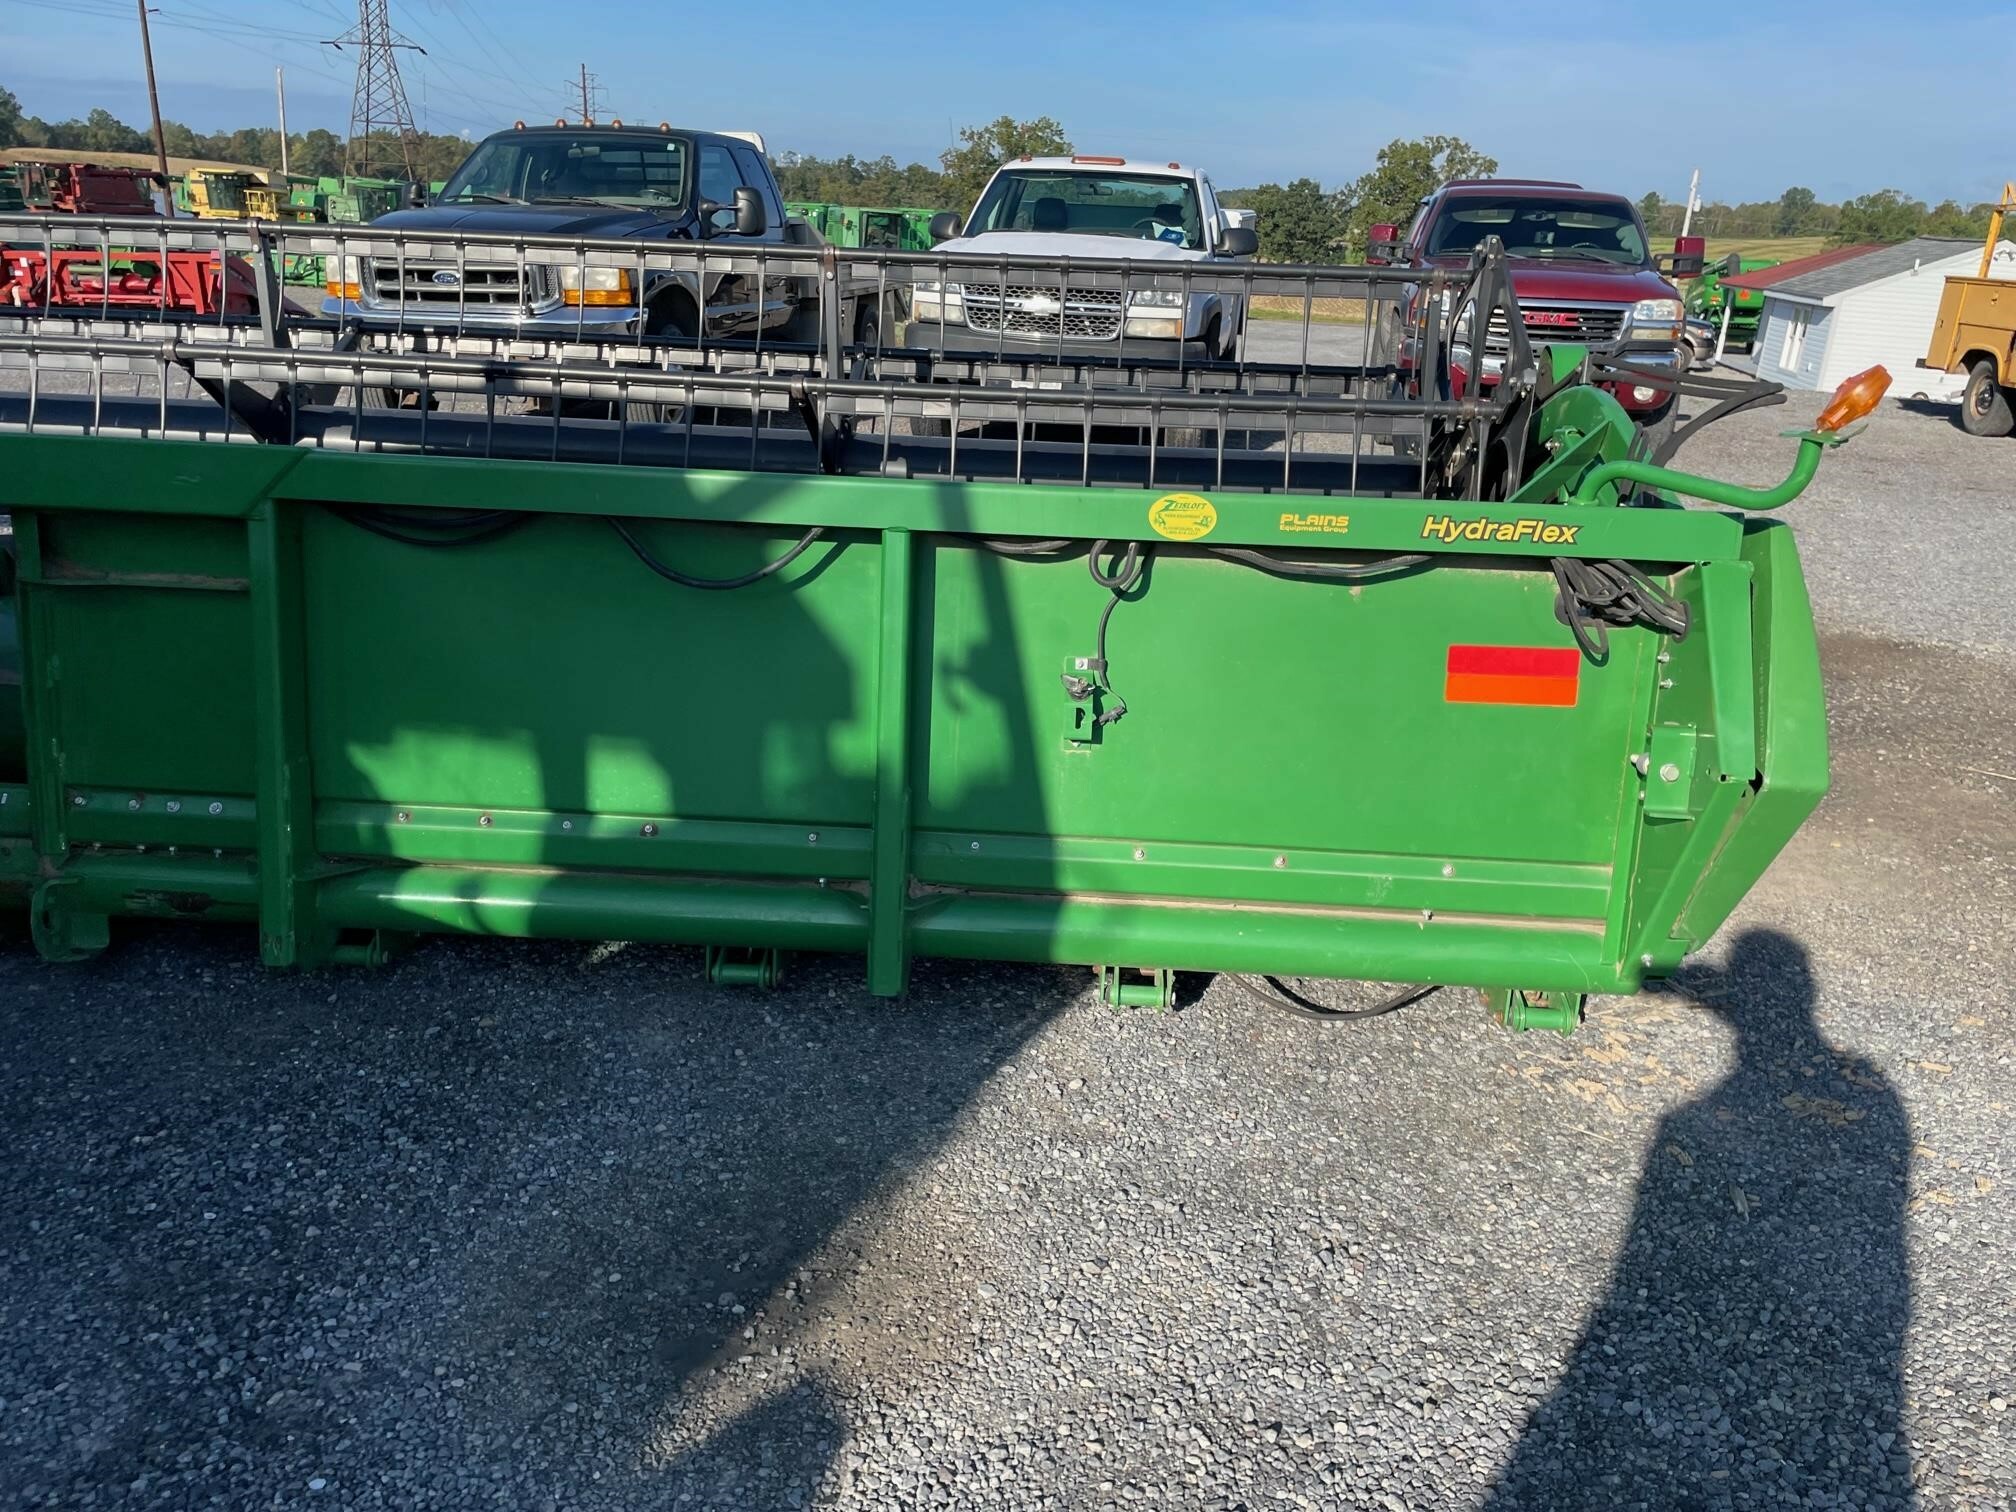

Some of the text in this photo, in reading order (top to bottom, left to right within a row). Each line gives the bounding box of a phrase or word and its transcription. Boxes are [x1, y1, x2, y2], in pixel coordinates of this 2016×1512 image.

[1524, 311, 1578, 326] GMC
[1279, 513, 1350, 527] PLAINS
[1279, 524, 1349, 534] Equipment Group
[1421, 515, 1584, 545] HydraFlex
